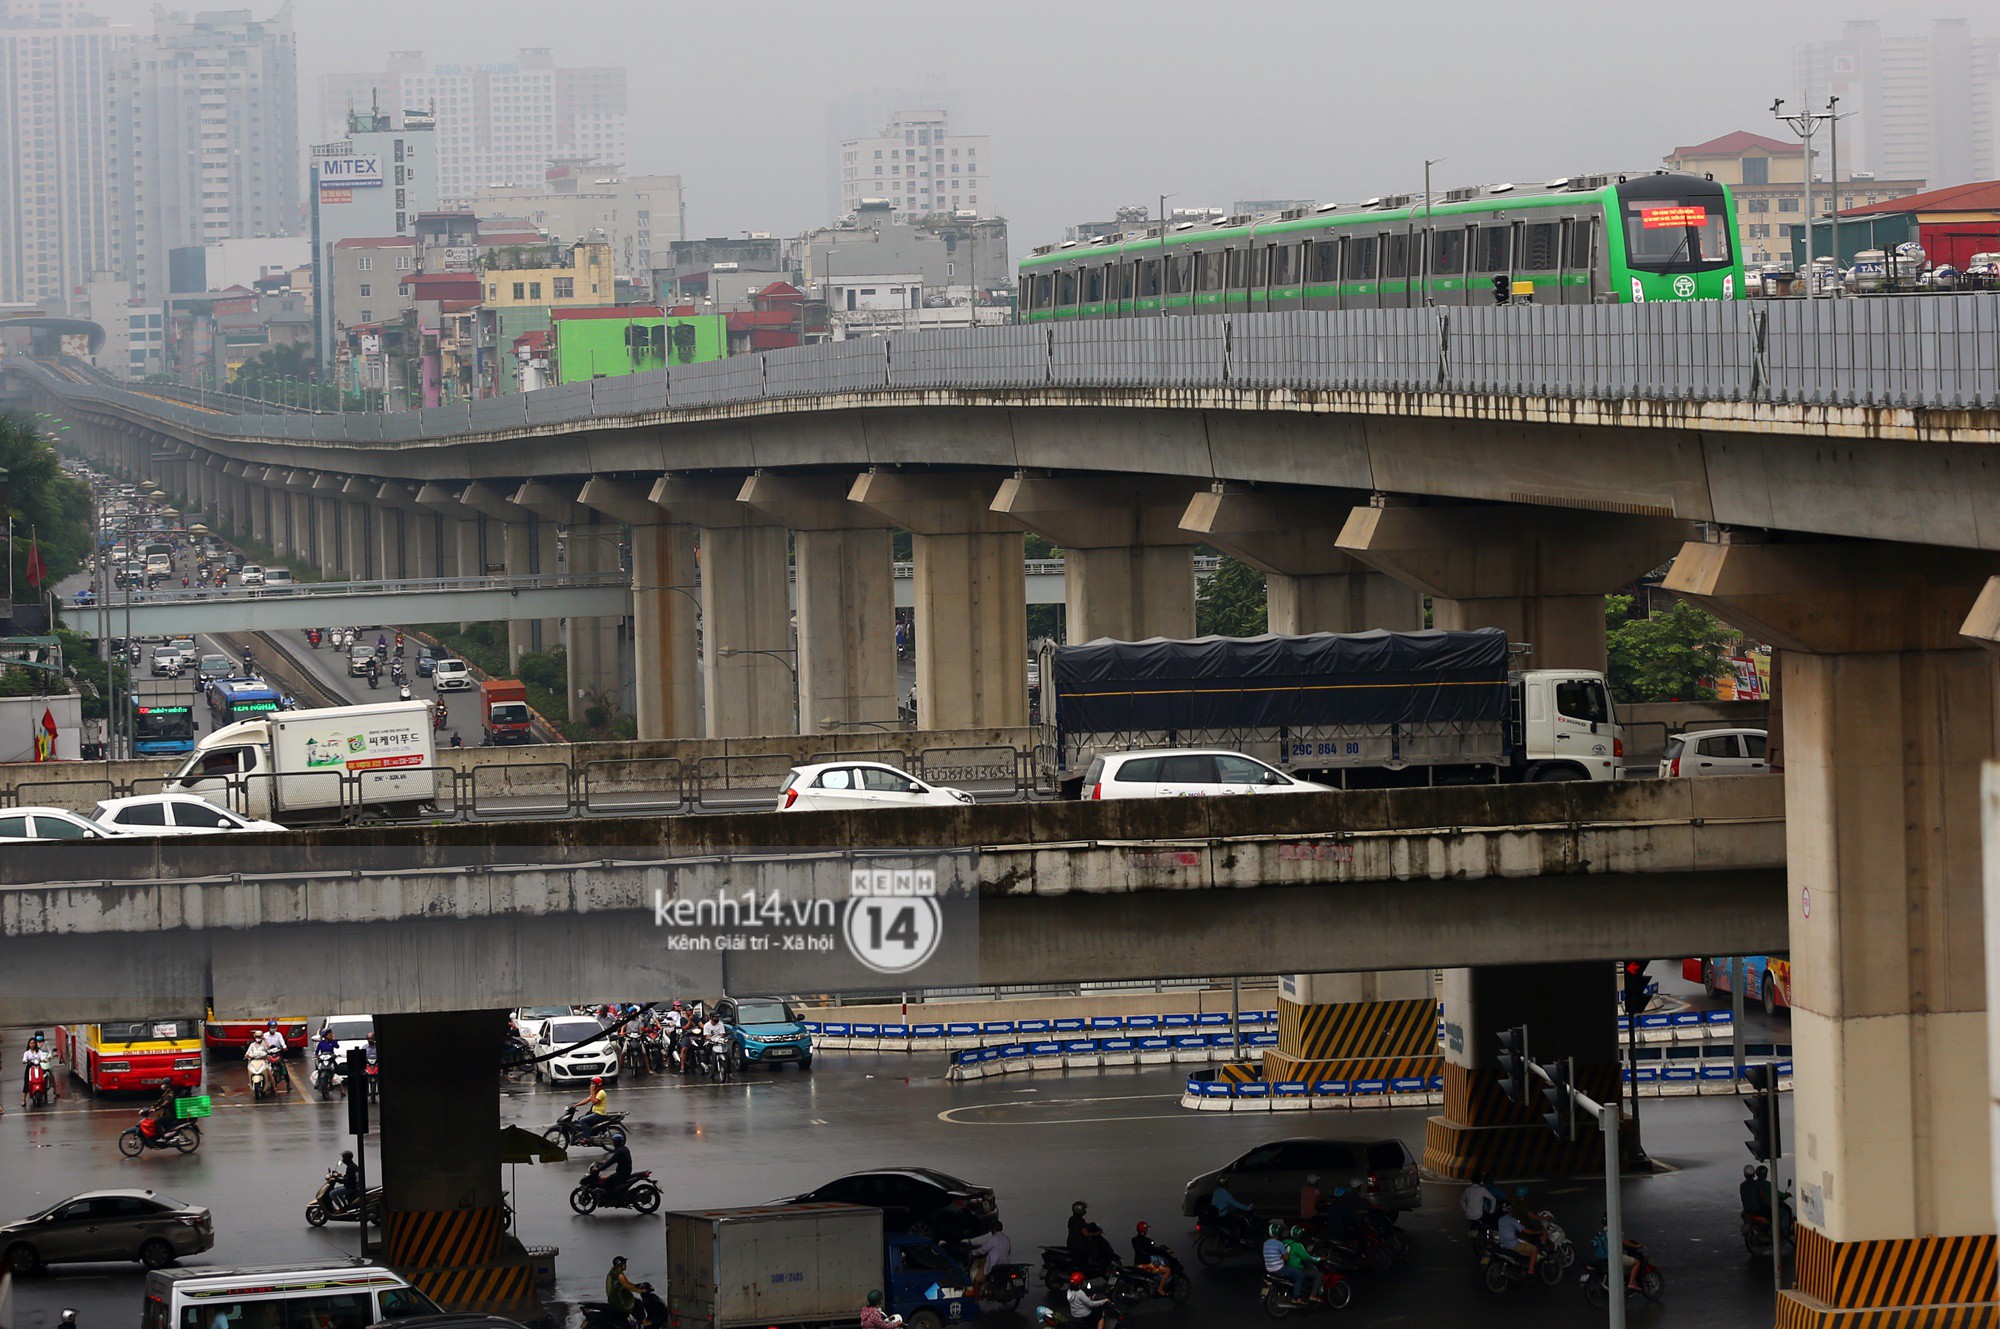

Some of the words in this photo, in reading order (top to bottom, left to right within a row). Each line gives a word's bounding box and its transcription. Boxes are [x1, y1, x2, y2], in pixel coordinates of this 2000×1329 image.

[369, 733, 420, 746] 씨케이푸드
[1292, 743, 1312, 755] 29C
[1318, 743, 1337, 755] 864
[1346, 742, 1359, 754] 80
